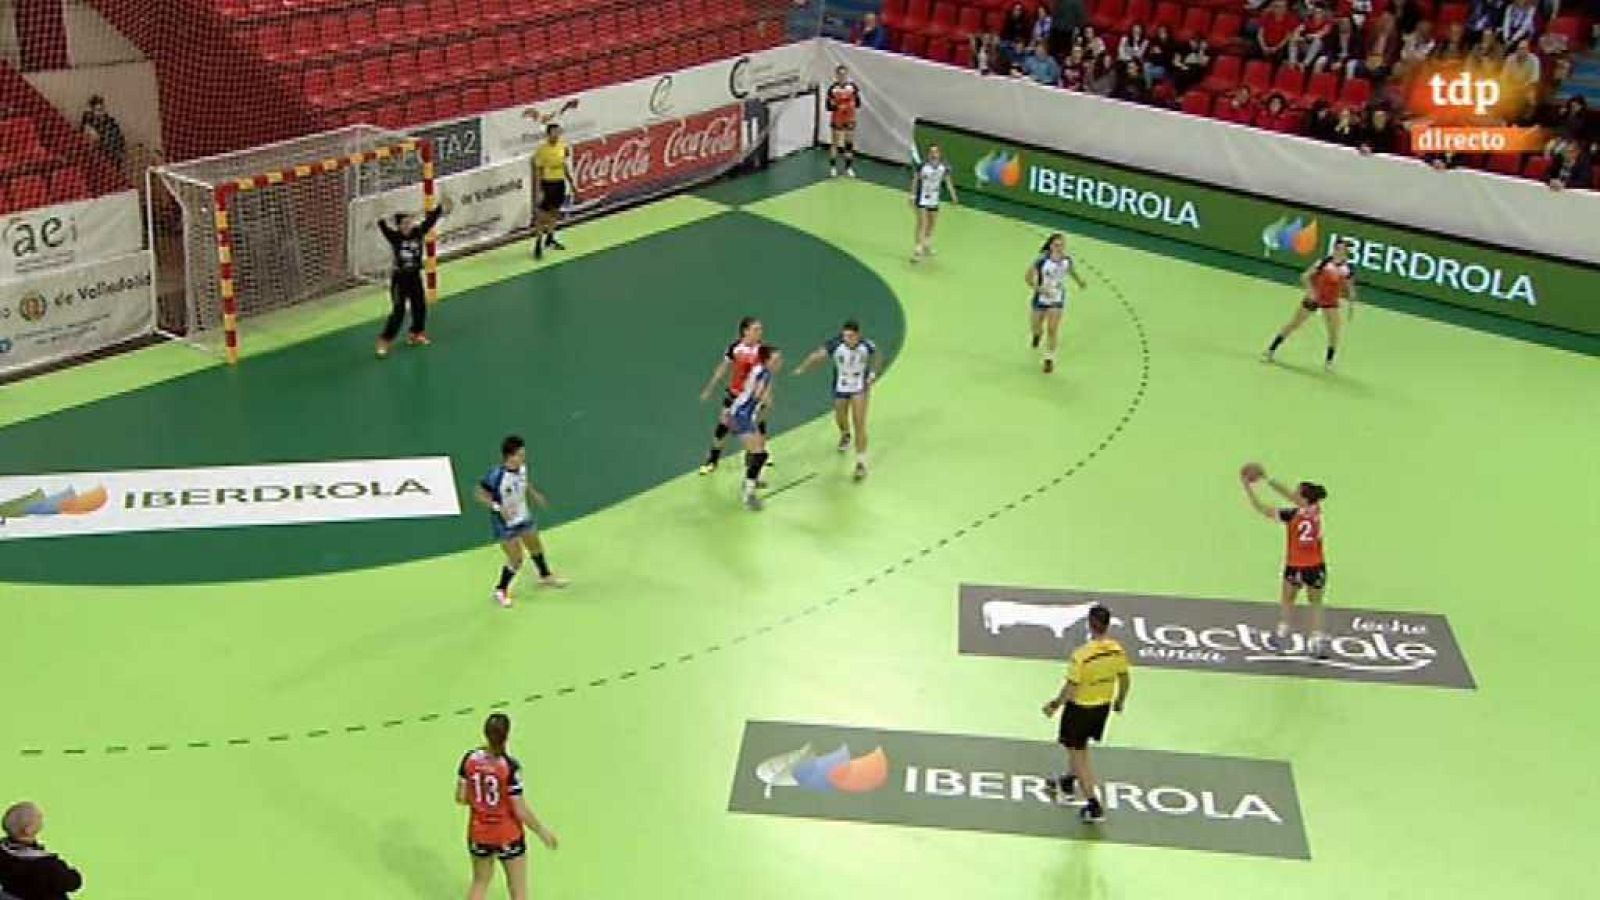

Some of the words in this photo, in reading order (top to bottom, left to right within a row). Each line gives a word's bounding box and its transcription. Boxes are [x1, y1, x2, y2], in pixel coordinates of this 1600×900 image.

[1029, 165, 1200, 229] IBERDROLA
[1328, 233, 1537, 306] IBERDROLA
[123, 478, 432, 509] IBERDROLA
[471, 772, 500, 806] 13
